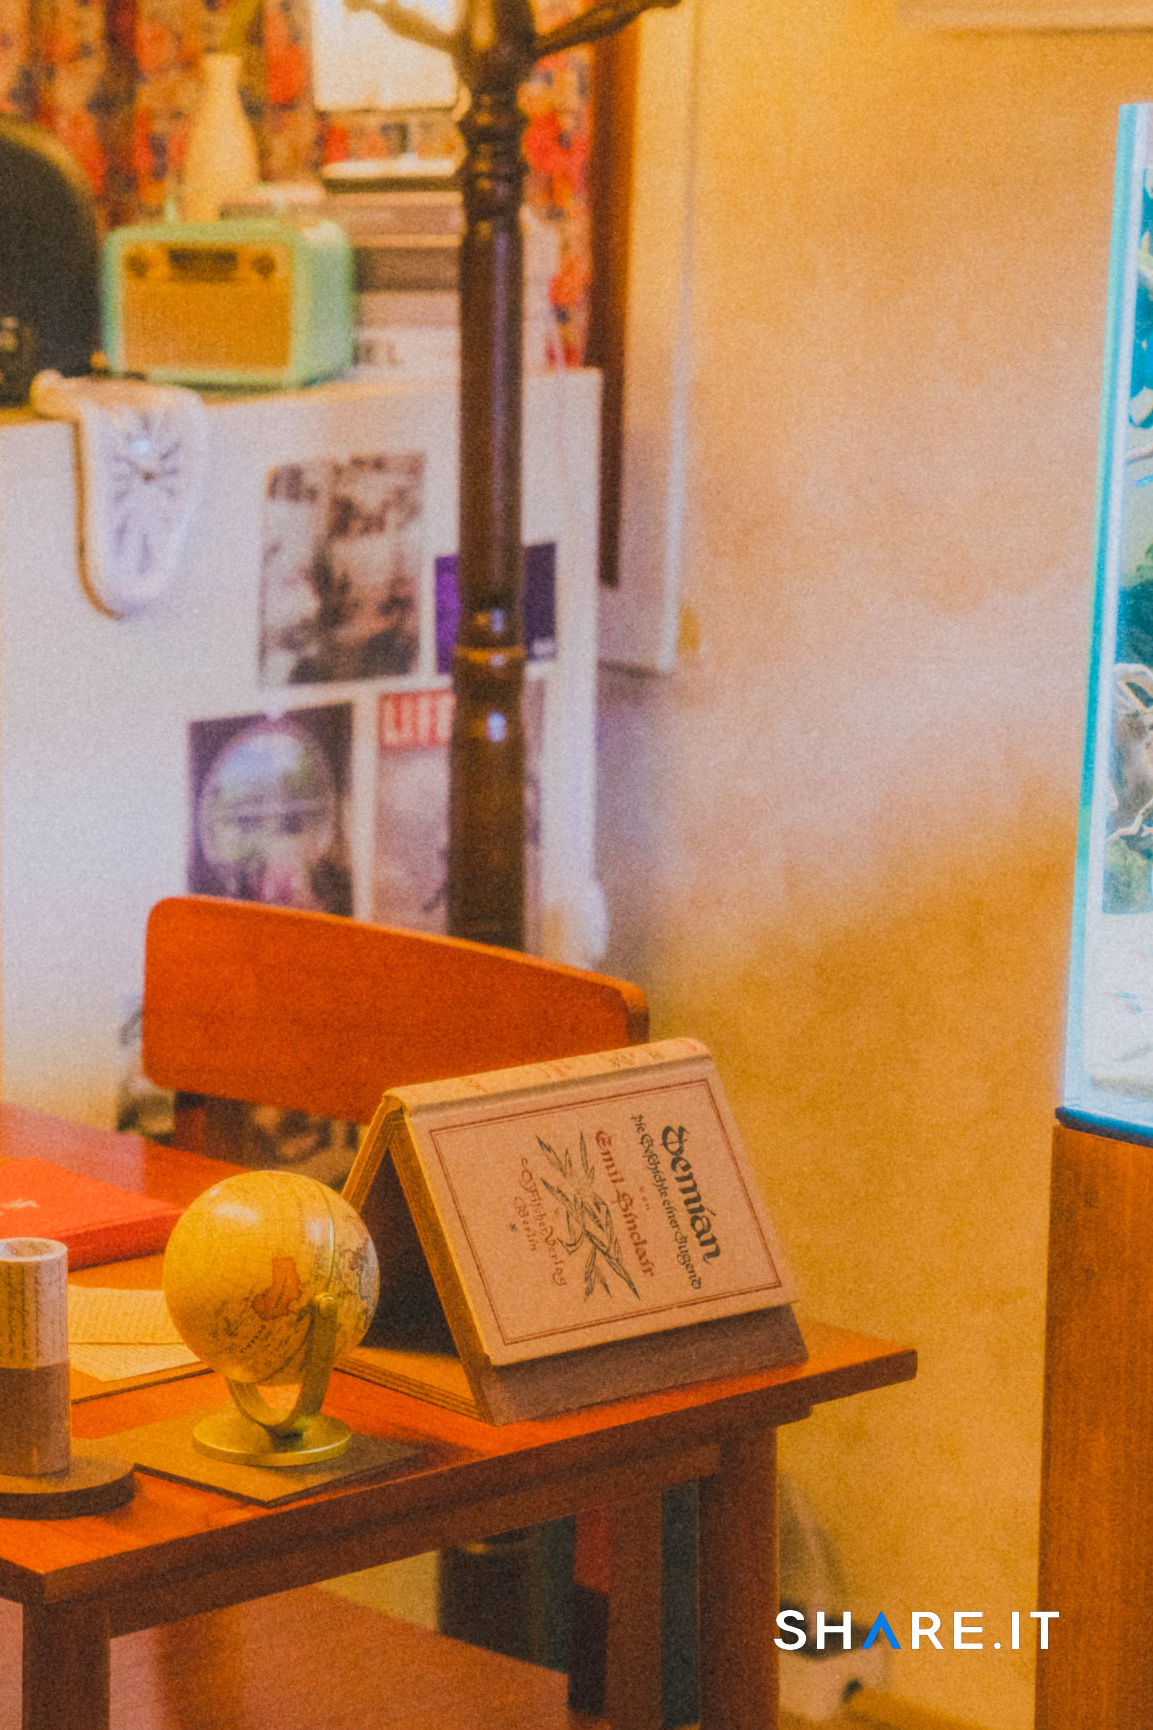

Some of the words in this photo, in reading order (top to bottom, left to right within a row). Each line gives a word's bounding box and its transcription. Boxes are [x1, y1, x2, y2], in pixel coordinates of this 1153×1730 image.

[514, 1196, 539, 1252] Berlin
[595, 1129, 624, 1186] Emil
[611, 1189, 655, 1278] Sinclair
[662, 1124, 722, 1266] Demian
[662, 1199, 680, 1232] einer
[672, 1227, 702, 1291] Jugend
